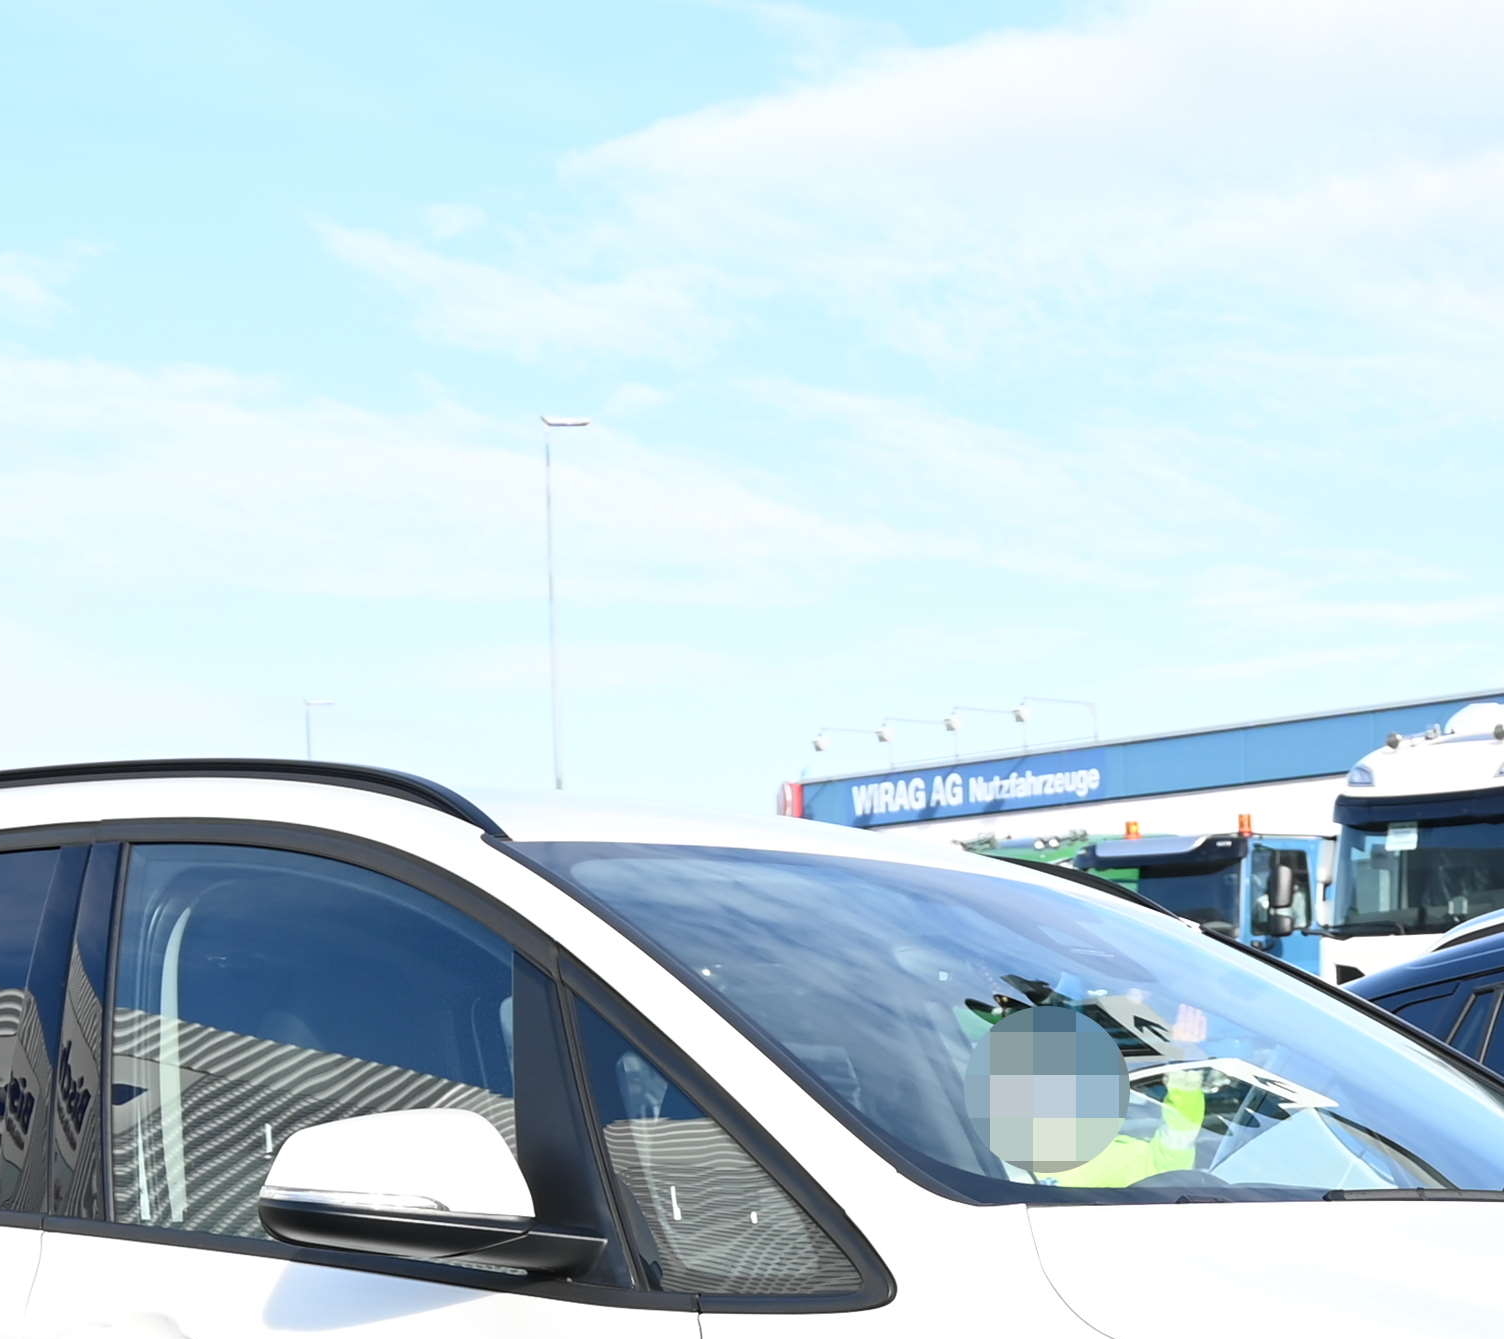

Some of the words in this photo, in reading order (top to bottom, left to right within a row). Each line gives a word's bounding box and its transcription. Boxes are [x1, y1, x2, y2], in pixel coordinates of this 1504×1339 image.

[851, 777, 927, 816] WIRAG
[930, 772, 964, 807] AG
[968, 767, 1101, 803] Nutzfahrzeuge
